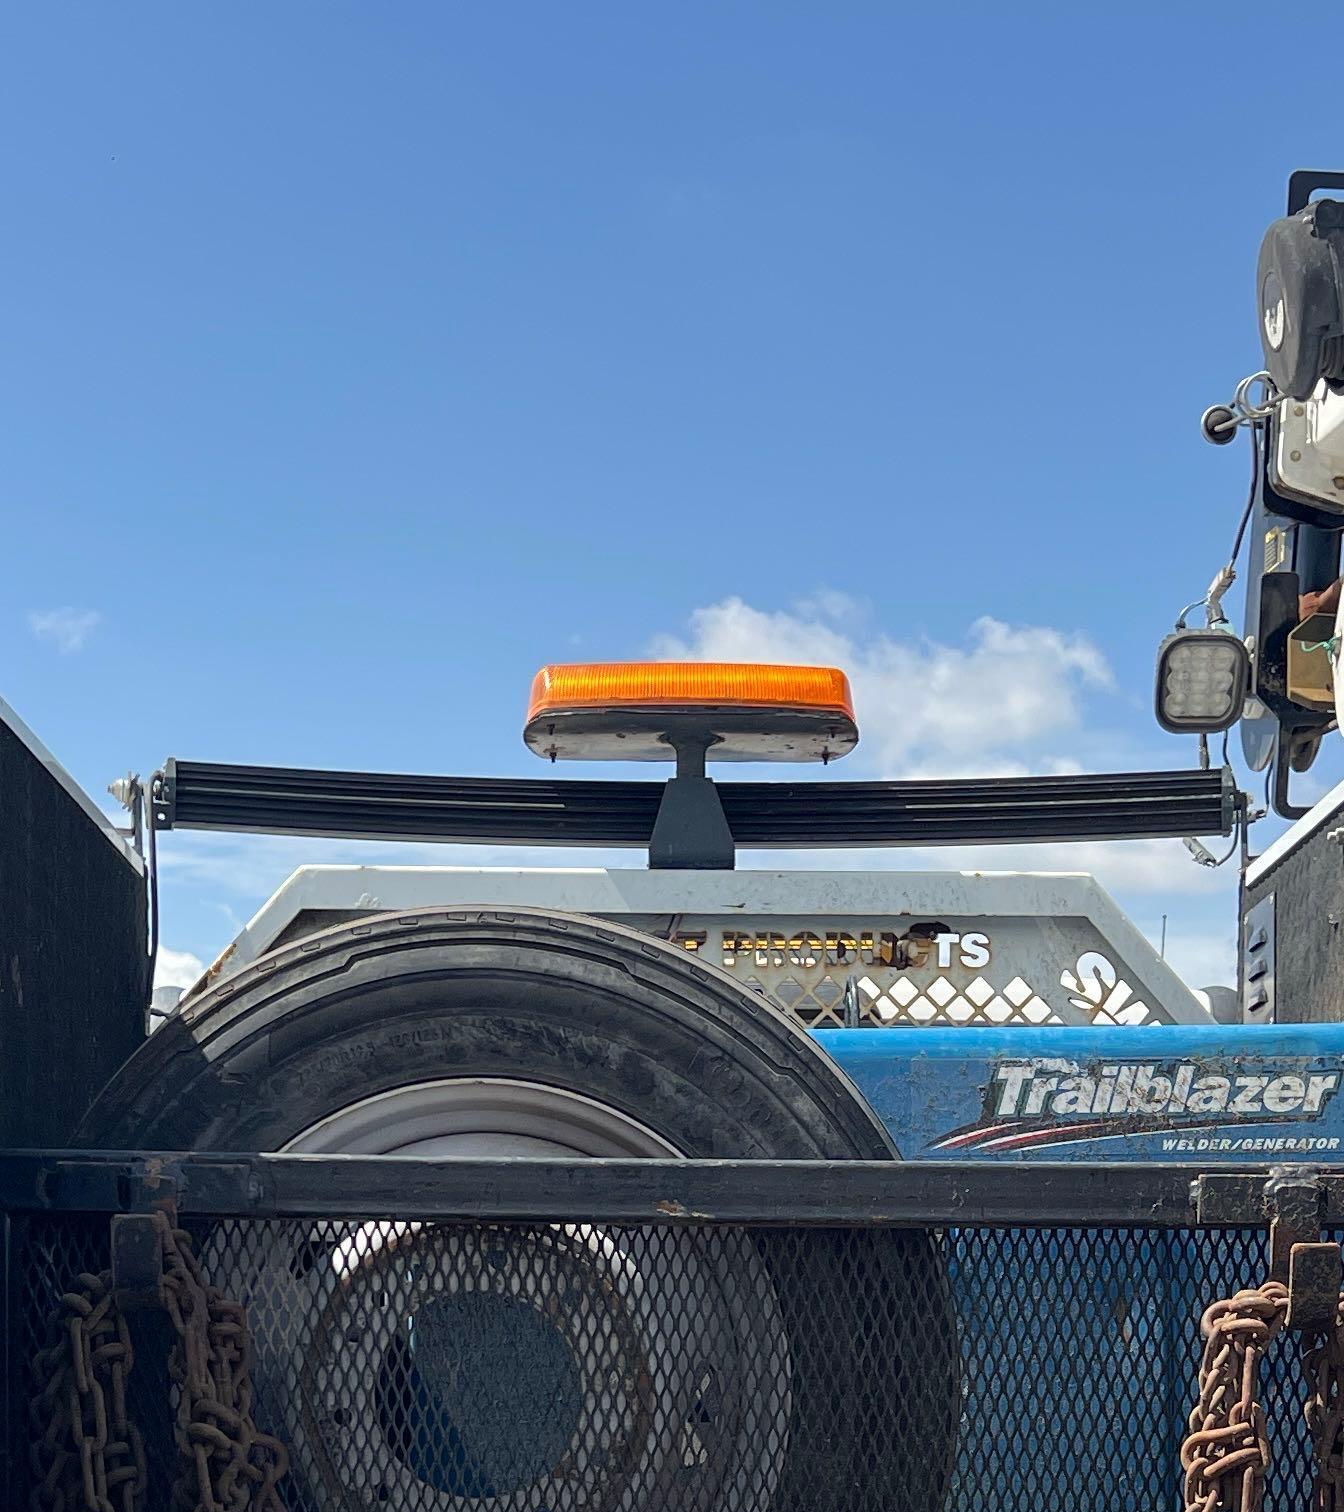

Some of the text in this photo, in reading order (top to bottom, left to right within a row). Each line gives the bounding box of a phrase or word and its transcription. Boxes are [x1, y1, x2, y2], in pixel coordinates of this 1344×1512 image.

[722, 931, 991, 969] PRODUCTS
[996, 1063, 1338, 1117] Trailblazer
[1162, 1137, 1341, 1152] WELDER/GENERATOR
